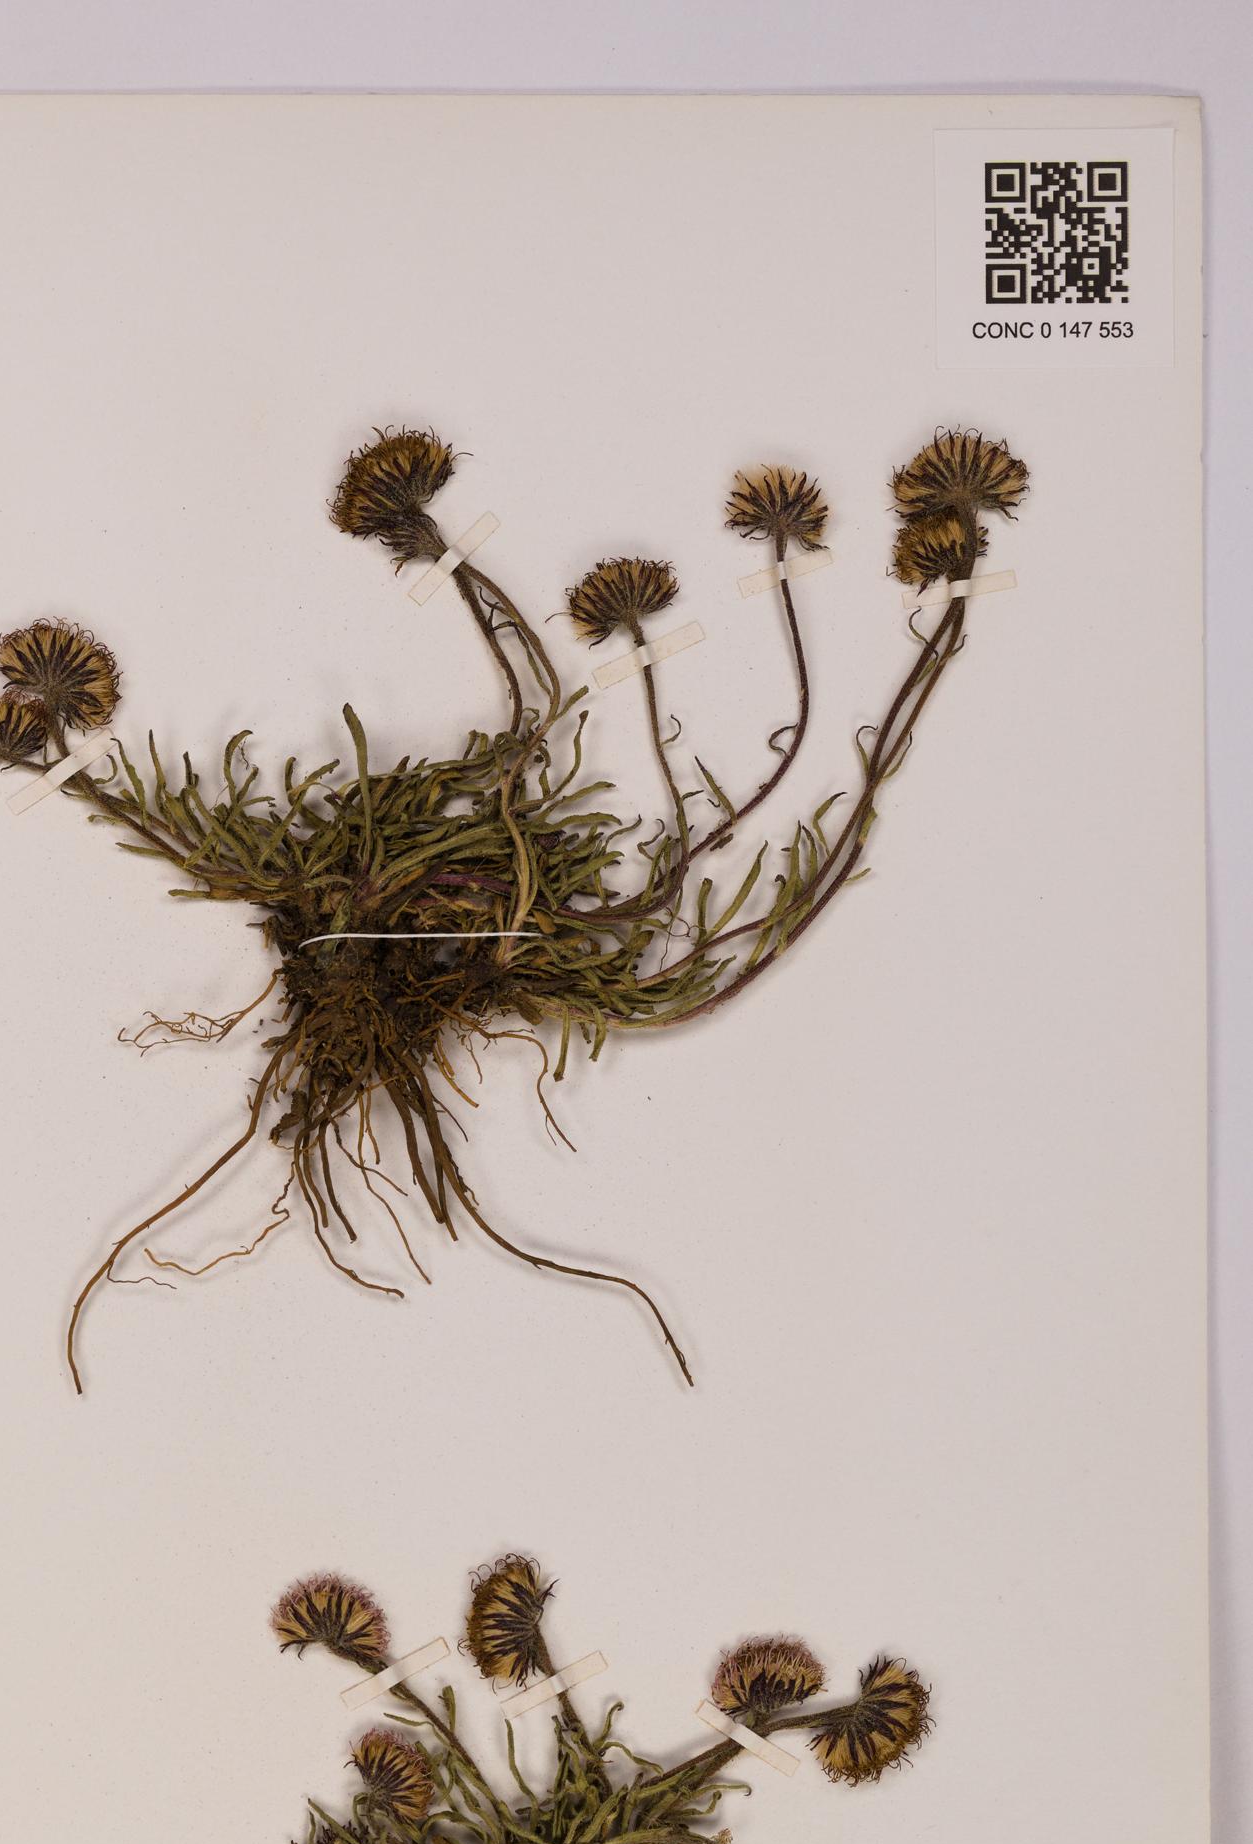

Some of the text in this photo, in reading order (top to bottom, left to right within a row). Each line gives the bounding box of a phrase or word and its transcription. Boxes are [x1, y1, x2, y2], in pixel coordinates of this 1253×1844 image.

[971, 320, 1134, 340] CONC 0 147 553
